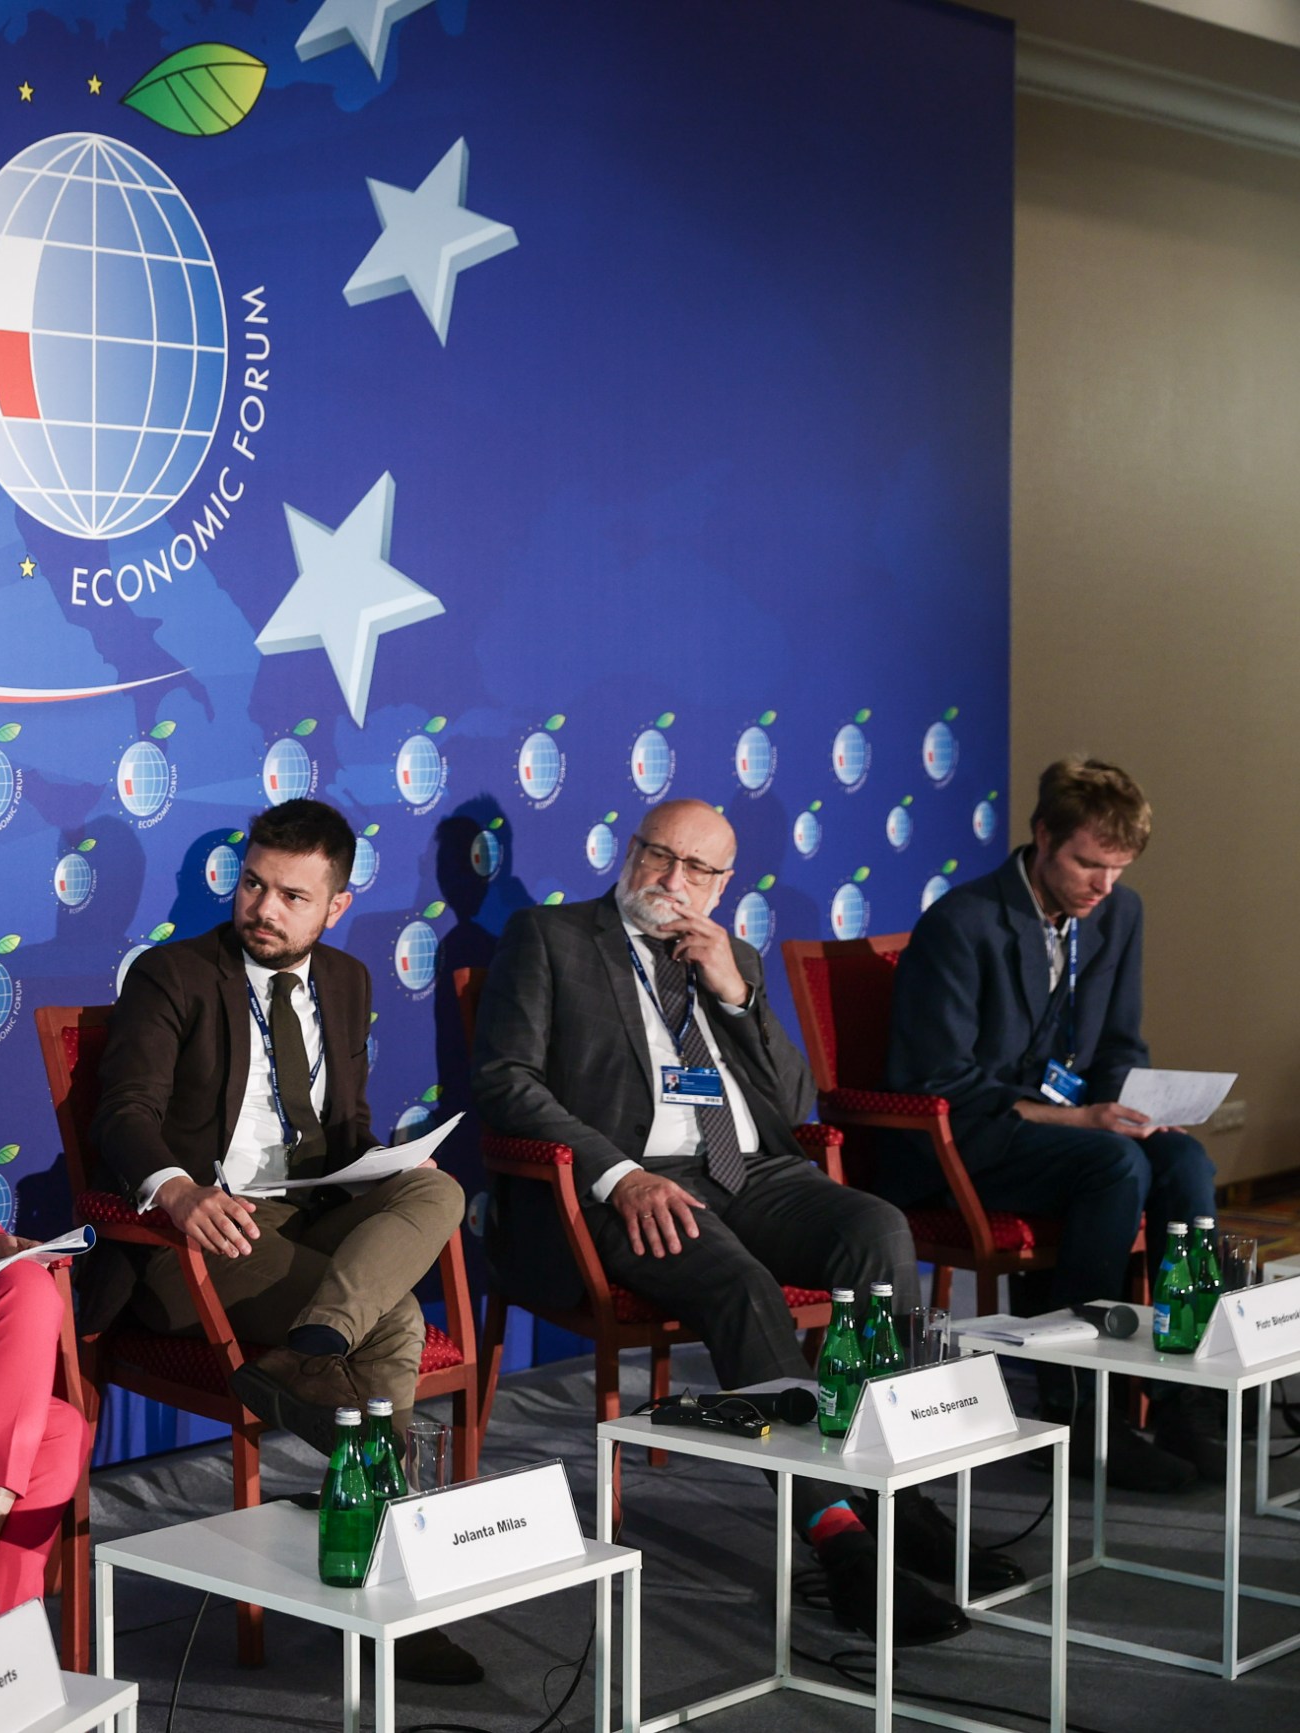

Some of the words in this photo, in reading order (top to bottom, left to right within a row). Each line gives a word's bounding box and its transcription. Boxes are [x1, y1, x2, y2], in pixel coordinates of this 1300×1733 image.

[71, 466, 245, 607] ECONOMIC
[232, 286, 271, 461] FORUM
[13, 768, 23, 805] FORUM
[137, 799, 173, 829] ECONOMIC
[168, 763, 178, 799] FORUM
[12, 979, 23, 1016] FORUM
[910, 1405, 939, 1421] Nicola
[939, 1396, 979, 1414] Speranza
[452, 1525, 495, 1546] Jolanta
[496, 1517, 527, 1533] Milas
